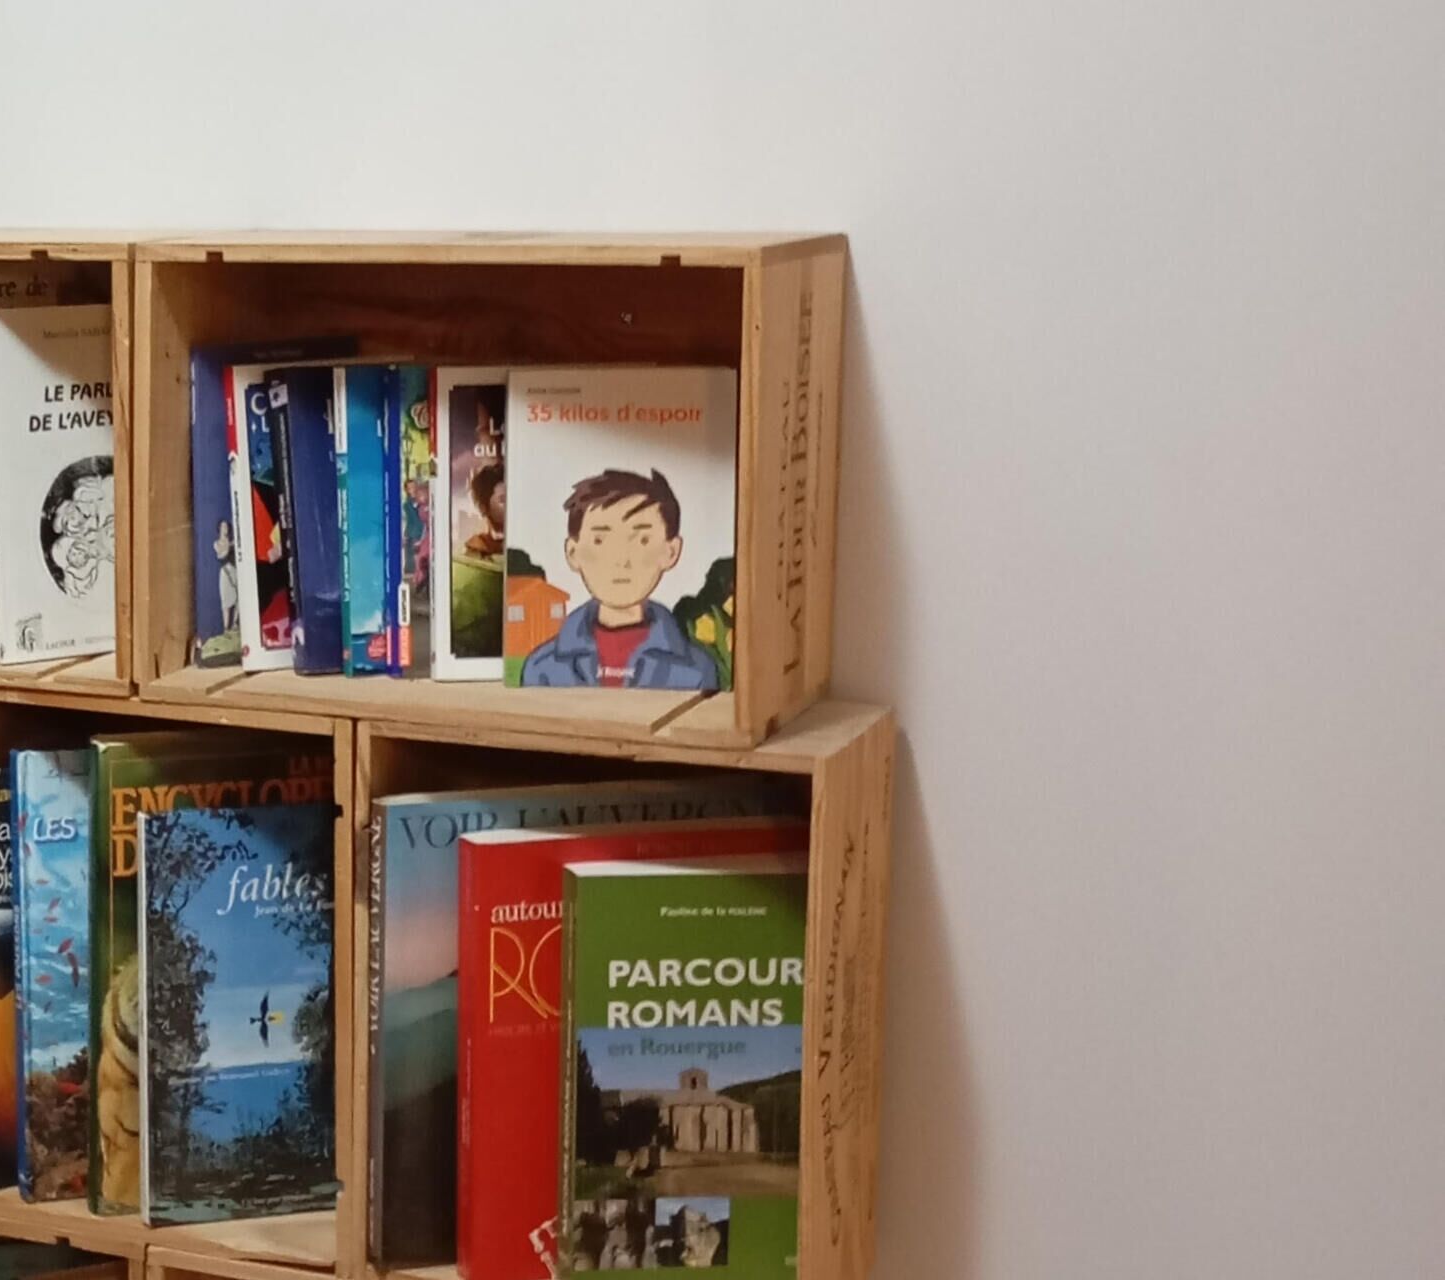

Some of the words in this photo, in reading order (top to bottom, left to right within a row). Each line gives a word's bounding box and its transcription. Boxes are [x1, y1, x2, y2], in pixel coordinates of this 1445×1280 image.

[25, 275, 50, 297] de
[44, 384, 65, 403] LE
[29, 414, 53, 433] DE
[527, 402, 553, 423] 35
[558, 402, 609, 423] kilos
[616, 401, 703, 427] d'espoir
[33, 816, 77, 843] LES
[216, 863, 328, 916] fables
[254, 905, 279, 918] Jean
[608, 957, 804, 989] PARCOUR
[606, 998, 784, 1030] ROMANS
[607, 1042, 634, 1058] en
[638, 1037, 747, 1060] Rouergue
